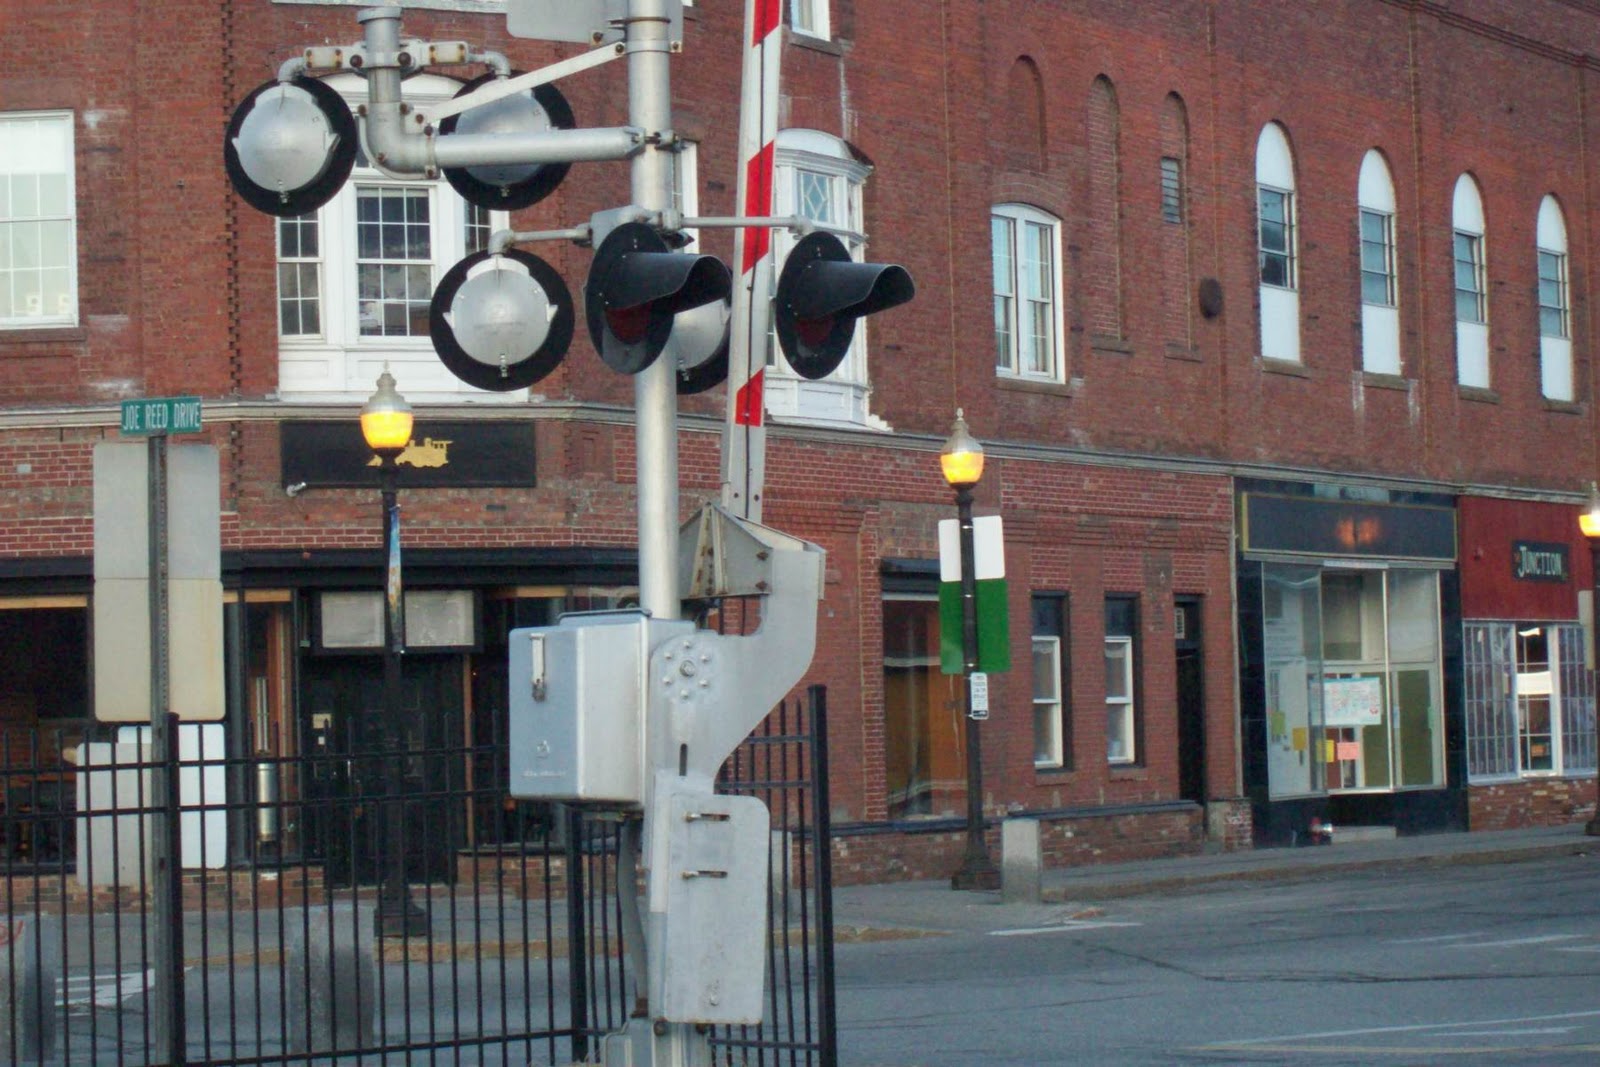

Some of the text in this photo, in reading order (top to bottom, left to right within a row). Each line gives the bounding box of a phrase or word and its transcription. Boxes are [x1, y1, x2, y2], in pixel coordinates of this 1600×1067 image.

[123, 402, 200, 430] JOE REED DRIVE
